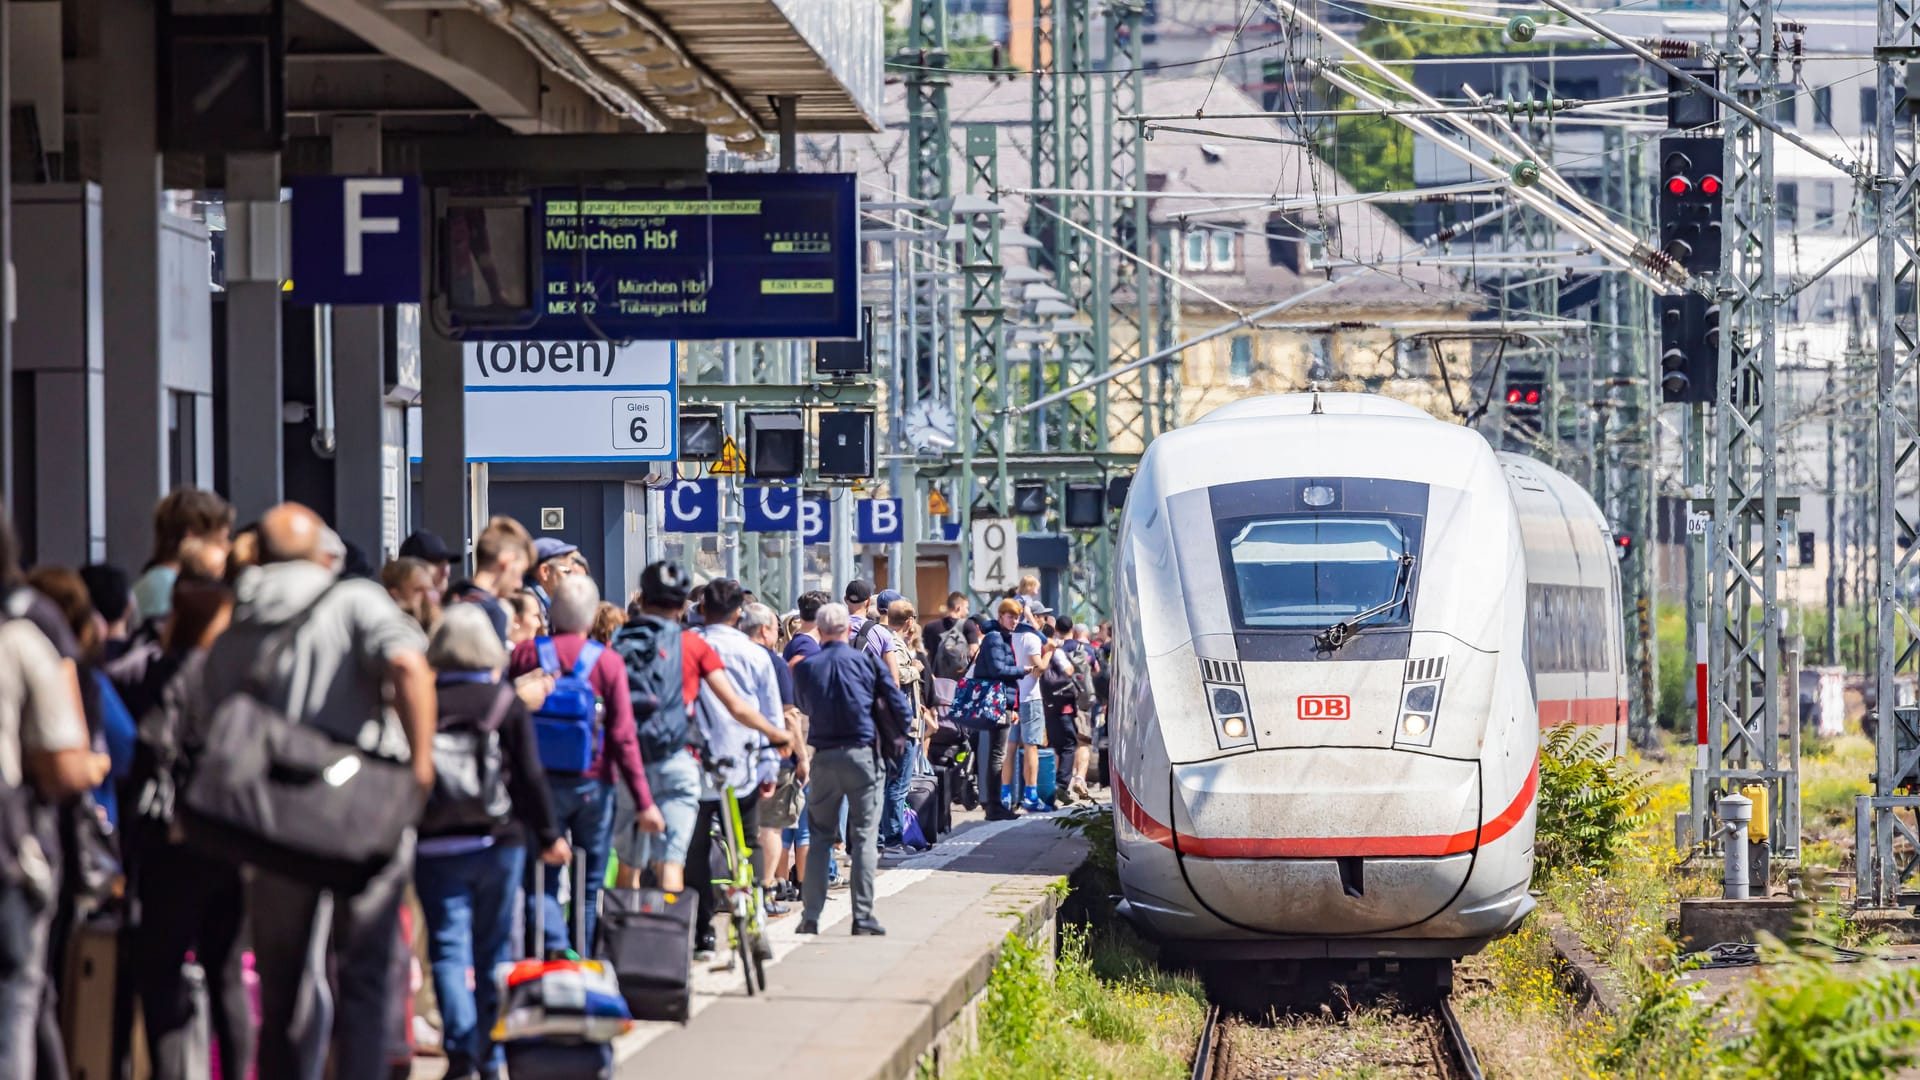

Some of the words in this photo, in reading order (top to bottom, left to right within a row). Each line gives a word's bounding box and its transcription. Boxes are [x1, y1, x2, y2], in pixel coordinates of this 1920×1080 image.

[344, 178, 404, 276] F
[598, 217, 647, 229] Augsburg
[546, 230, 636, 250] München
[643, 230, 678, 250] Hbf
[548, 281, 568, 294] ICE
[618, 279, 677, 294] München
[682, 279, 706, 294] Hbf
[548, 301, 576, 314] MEX
[582, 301, 596, 314] 12
[619, 299, 679, 317] Tübingen
[683, 299, 707, 314] Hbf
[476, 340, 616, 377] (oben)
[627, 403, 650, 412] Gleis
[629, 416, 648, 443] 6
[671, 481, 702, 521] C
[760, 478, 791, 520] C
[803, 501, 823, 536] B
[871, 499, 898, 534] B
[1303, 698, 1346, 718] DB
